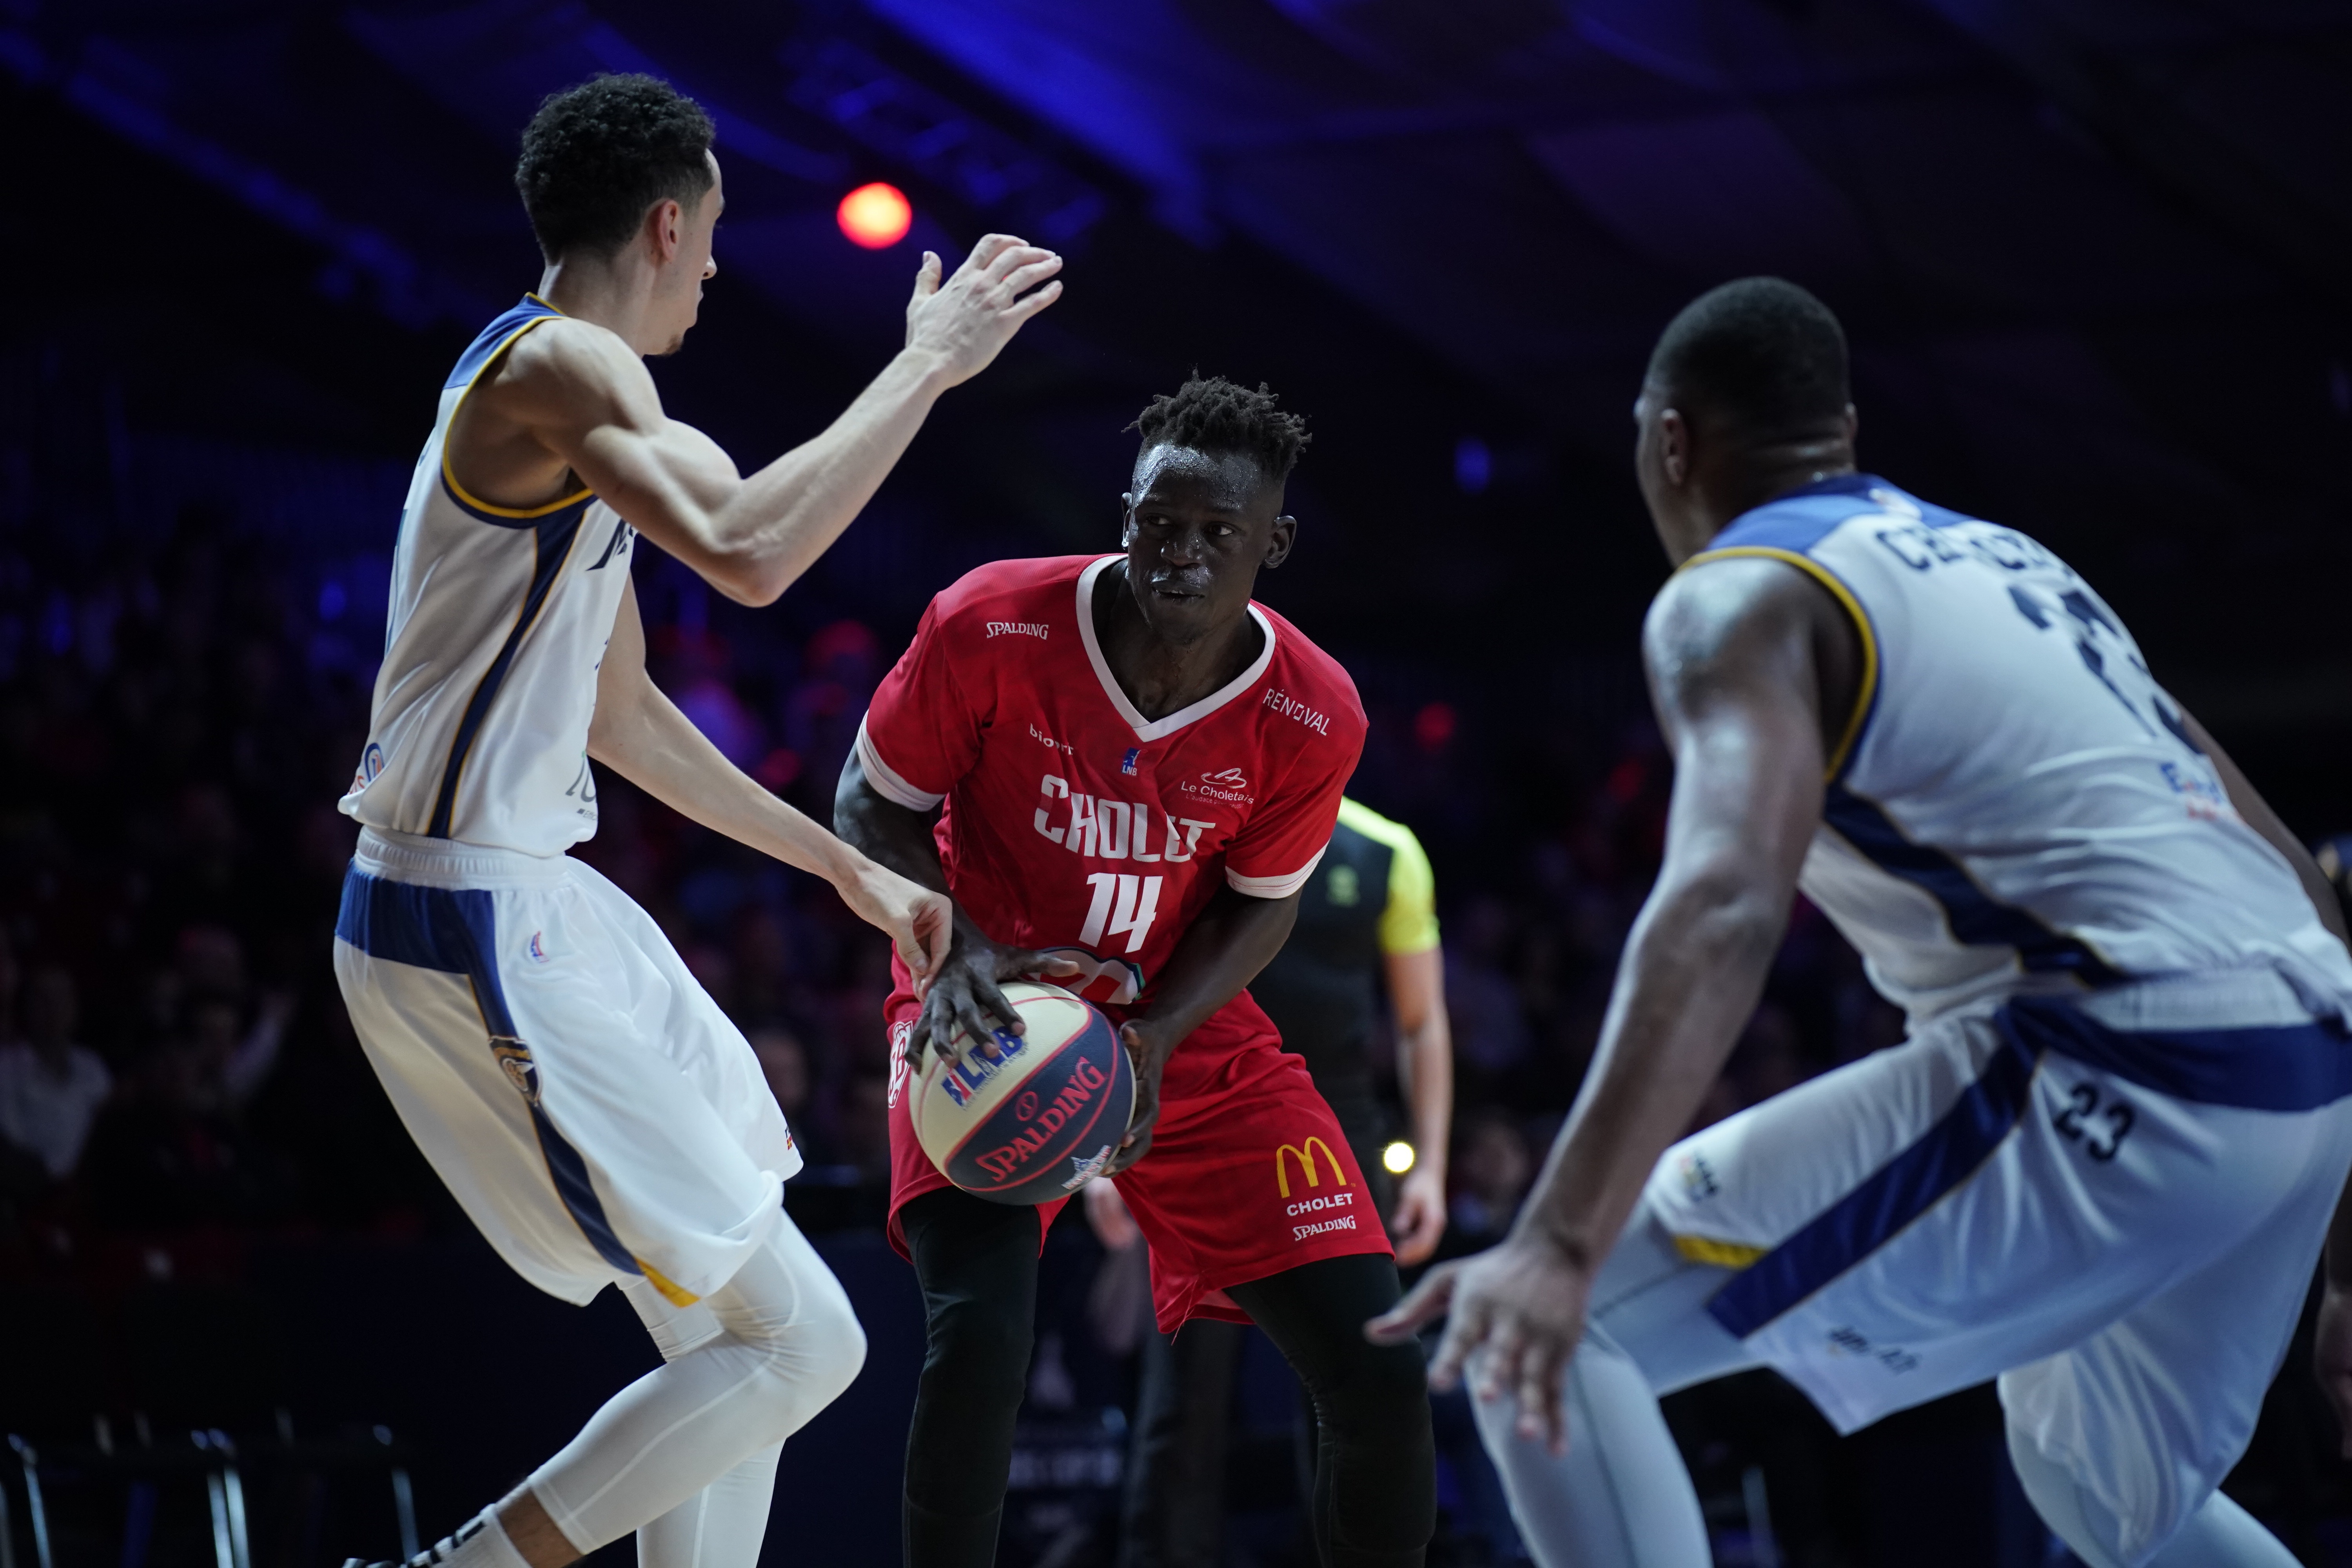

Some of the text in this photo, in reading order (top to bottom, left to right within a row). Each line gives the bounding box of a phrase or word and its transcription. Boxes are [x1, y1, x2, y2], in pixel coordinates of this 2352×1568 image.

[986, 622, 1049, 640] SPALDING
[1263, 689, 1330, 736] RÉNOVAL
[1122, 764, 1137, 776] LNB
[1181, 781, 1254, 804] Le Choletais
[1034, 774, 1216, 863] CHOLET
[1078, 872, 1163, 954] 14
[975, 1056, 1106, 1182] SPALDING
[2055, 1084, 2133, 1161] 23
[1287, 1192, 1353, 1216] CHOLET
[1292, 1215, 1356, 1241] SPALDING
